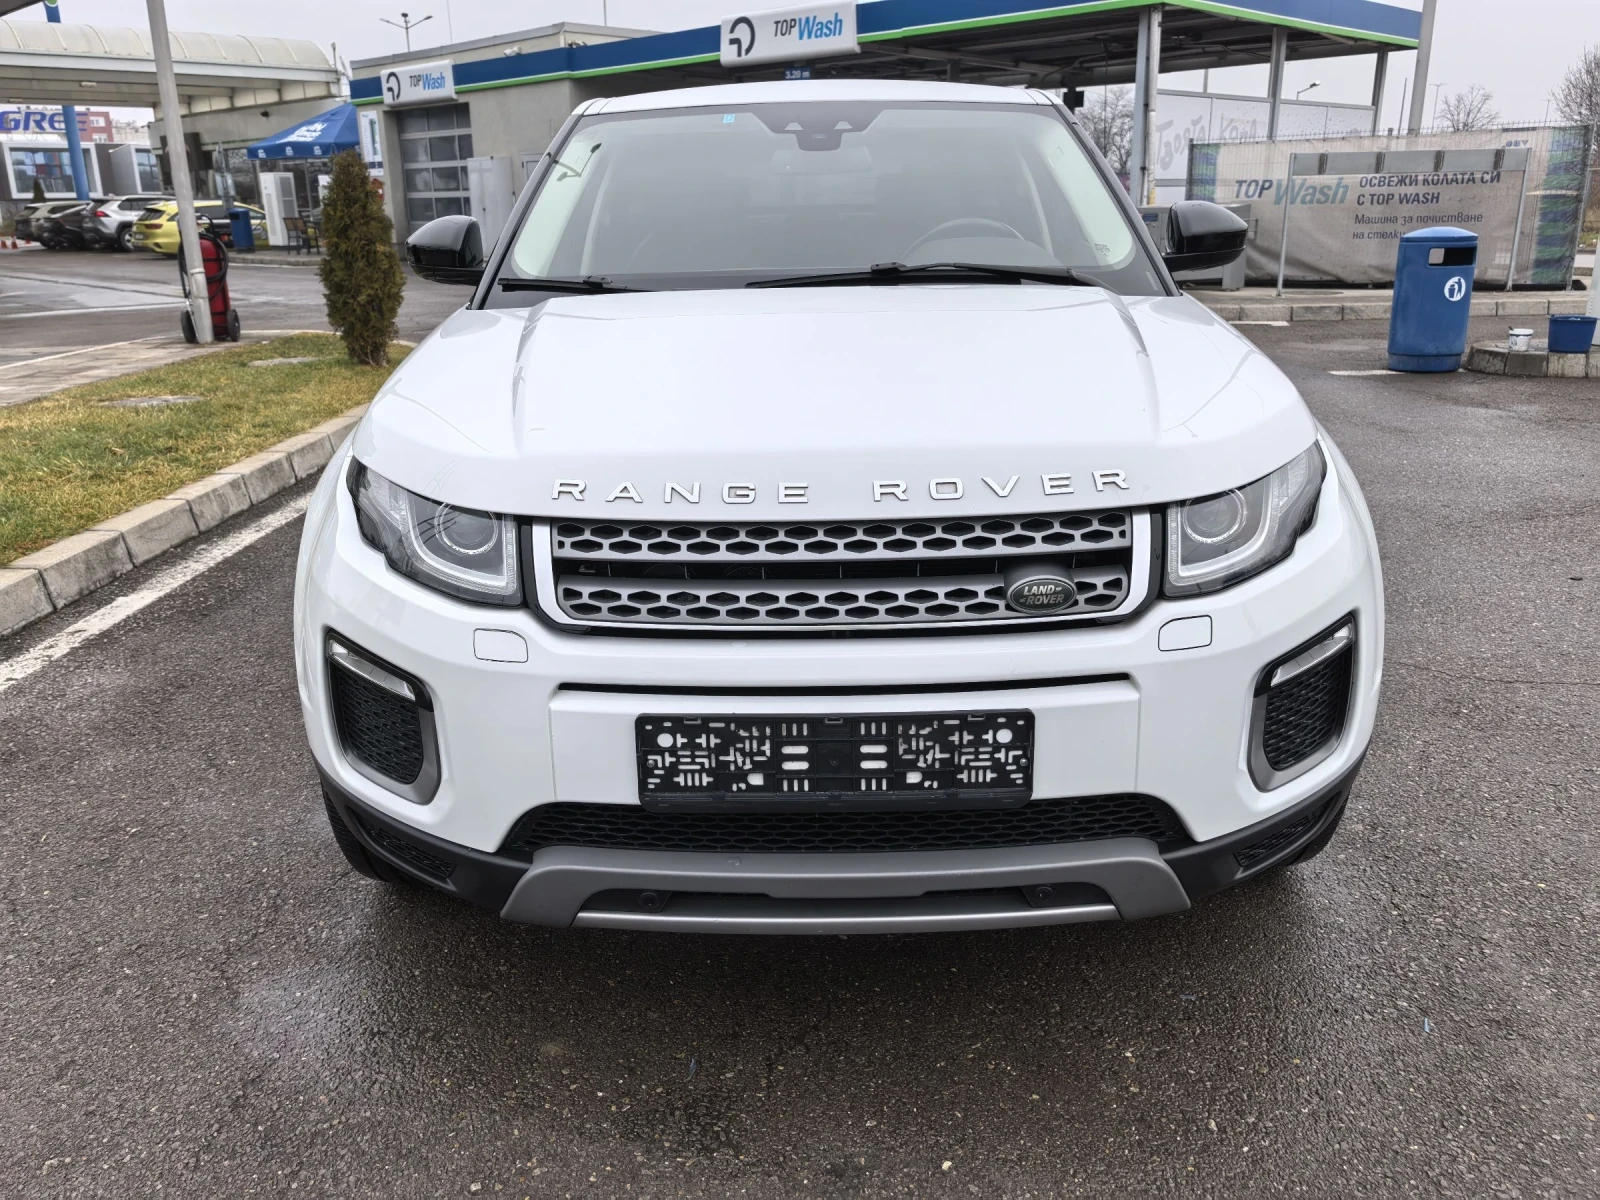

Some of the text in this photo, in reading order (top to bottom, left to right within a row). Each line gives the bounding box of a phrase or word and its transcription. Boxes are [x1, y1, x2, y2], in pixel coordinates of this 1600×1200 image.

[785, 70, 801, 79] 3.20
[1359, 170, 1501, 188] ОСВЕЖИ КОЛАТА СИ
[1369, 193, 1395, 206] TOP
[1399, 192, 1440, 205] WASH
[1354, 212, 1483, 226] Машина за почистване
[1352, 231, 1365, 240] на
[551, 468, 1130, 504] RANGE ROVER
